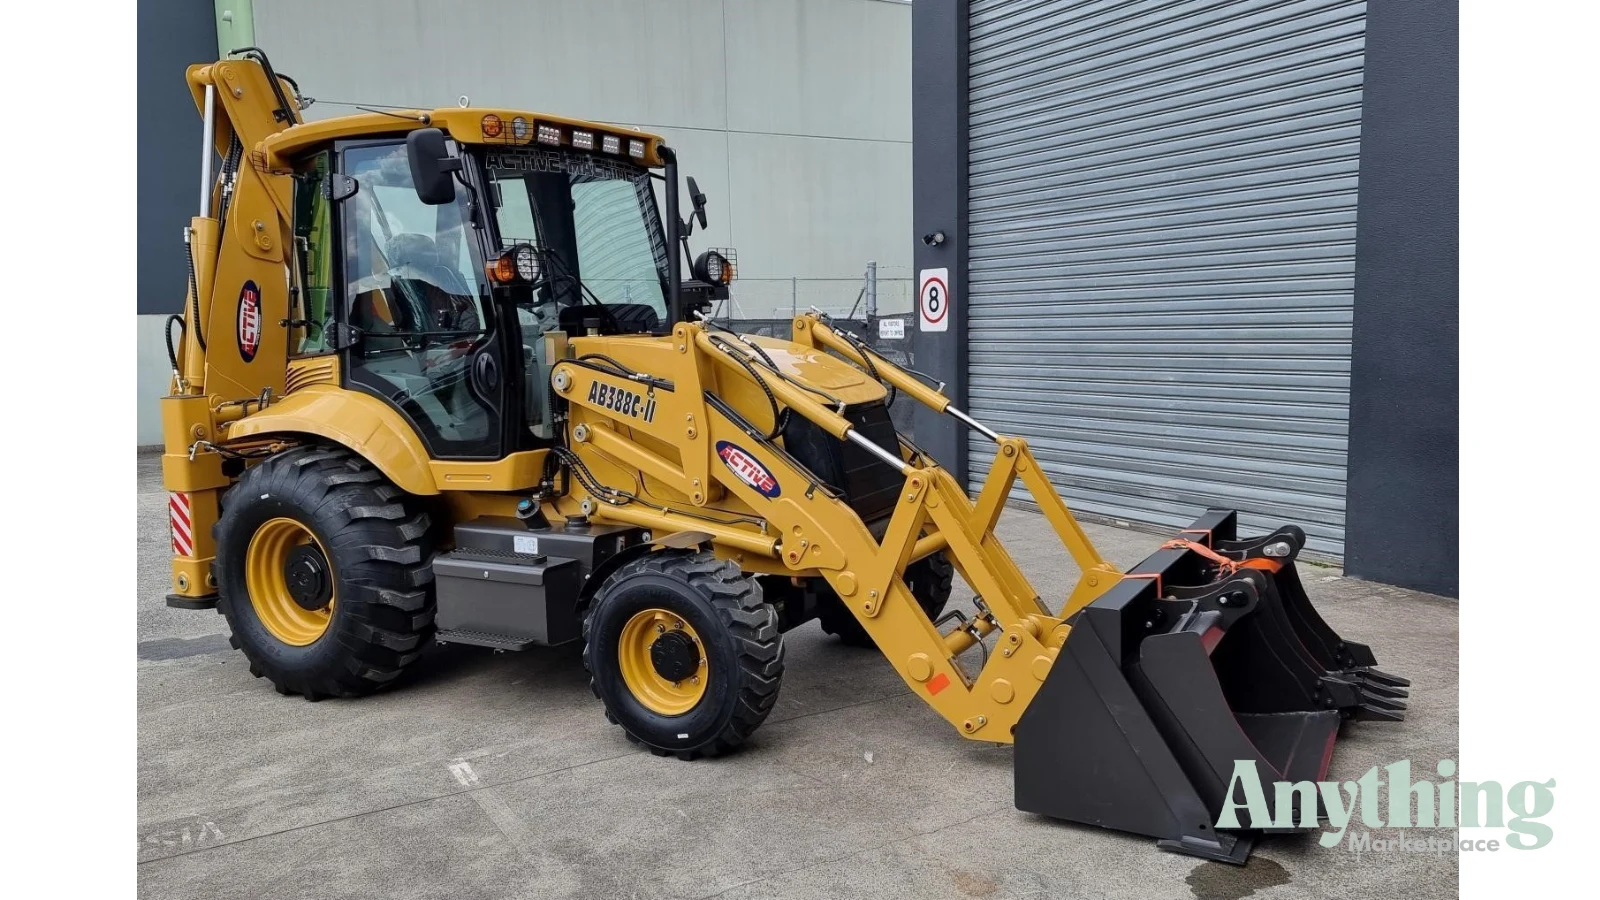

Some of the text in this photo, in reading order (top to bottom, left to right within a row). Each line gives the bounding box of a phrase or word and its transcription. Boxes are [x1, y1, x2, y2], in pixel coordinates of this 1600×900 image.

[485, 149, 562, 173] ACTIVE
[929, 286, 939, 313] 8
[241, 289, 257, 356] ACTIVE
[720, 445, 776, 493] ACTIVE
